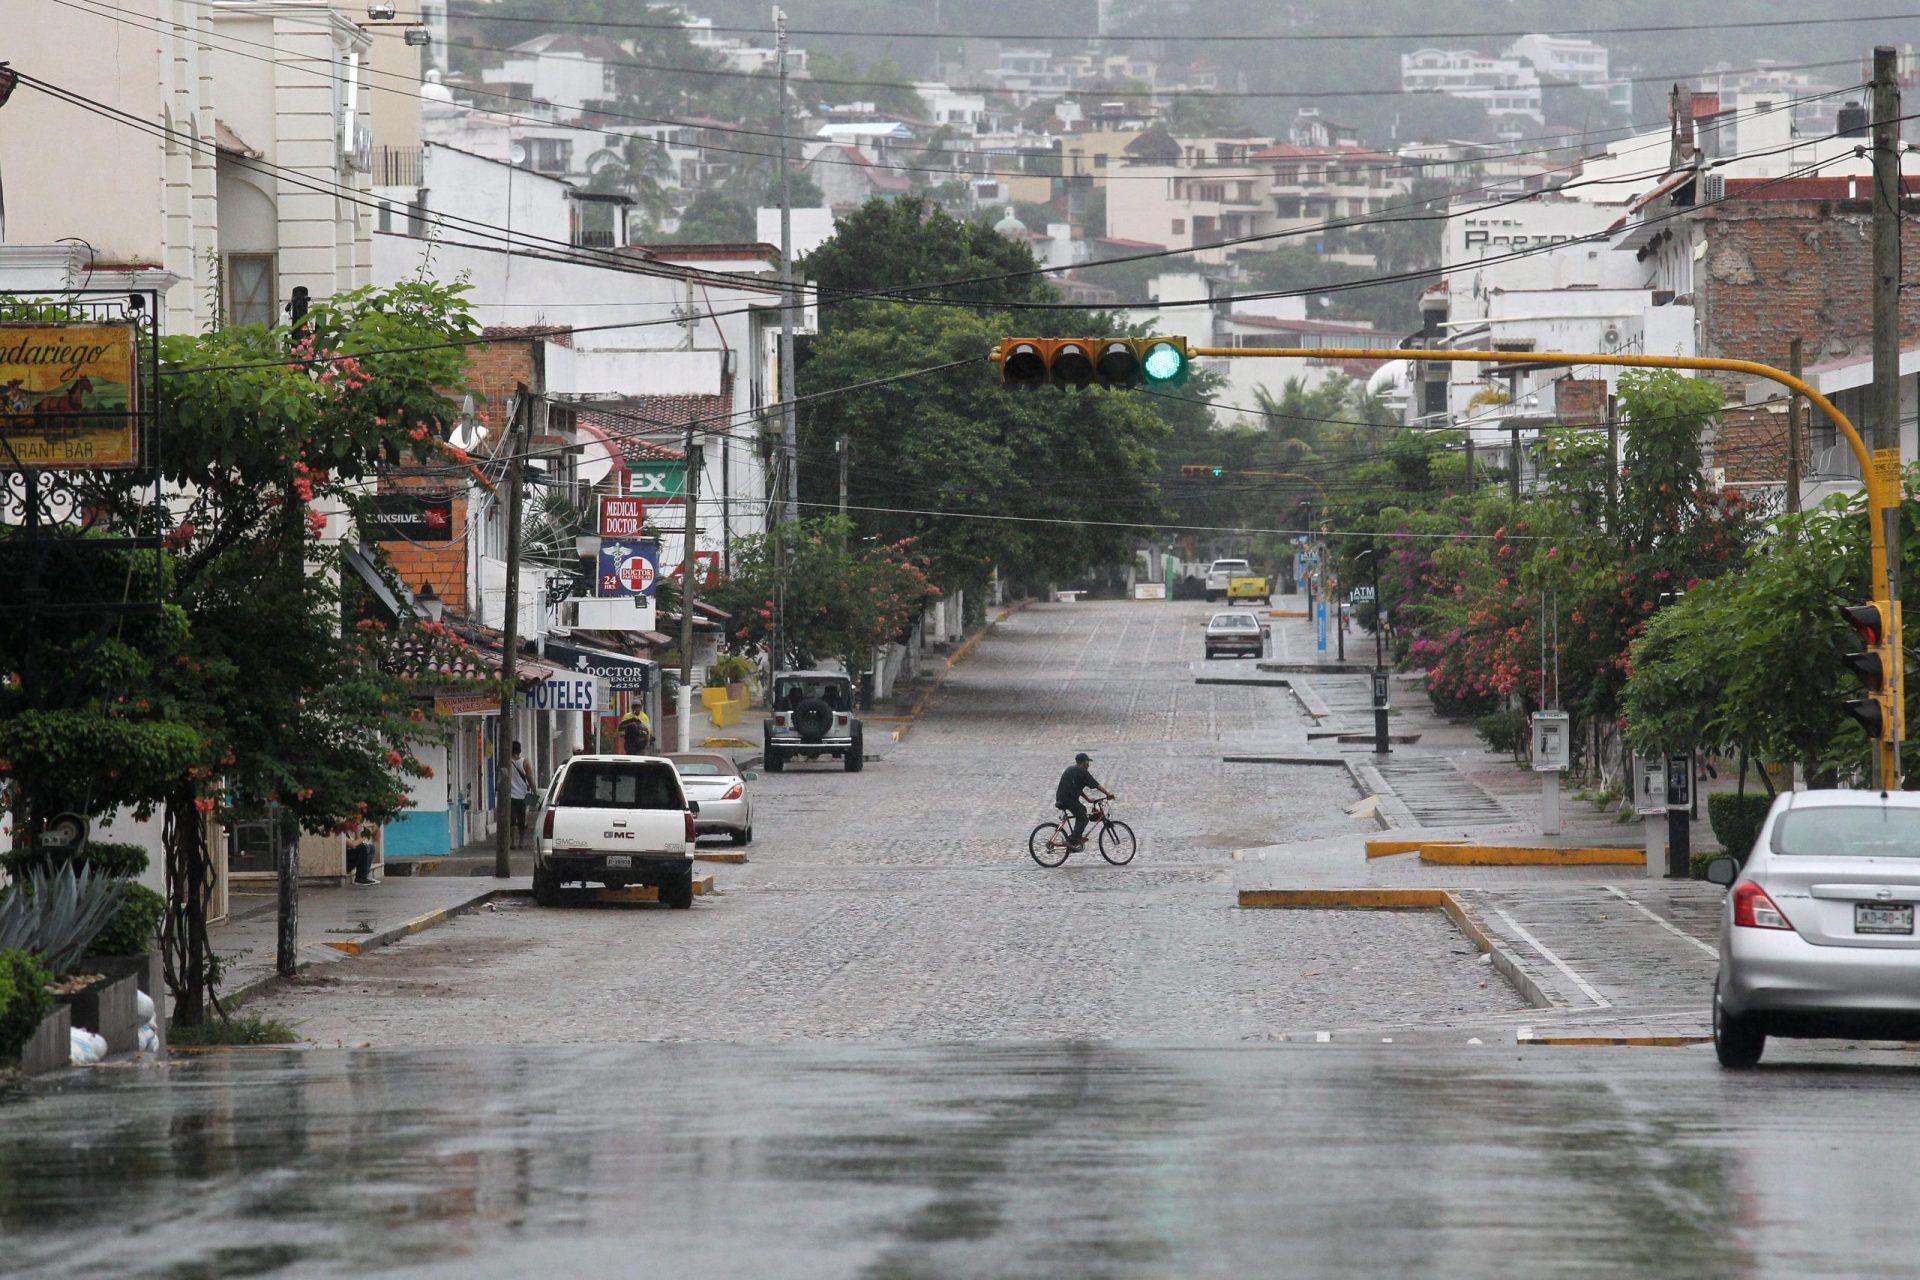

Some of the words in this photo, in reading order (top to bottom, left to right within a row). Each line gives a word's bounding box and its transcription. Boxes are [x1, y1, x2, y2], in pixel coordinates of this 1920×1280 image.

[65, 442, 94, 458] BAR
[607, 502, 638, 516] MEDICAL
[365, 513, 427, 523] IKSILVE
[607, 518, 638, 532] DOCTOR
[604, 576, 617, 585] 24
[1354, 587, 1375, 596] ATM
[586, 666, 641, 677] DOCTOR
[526, 681, 592, 709] HOTELES
[604, 831, 635, 839] GMC
